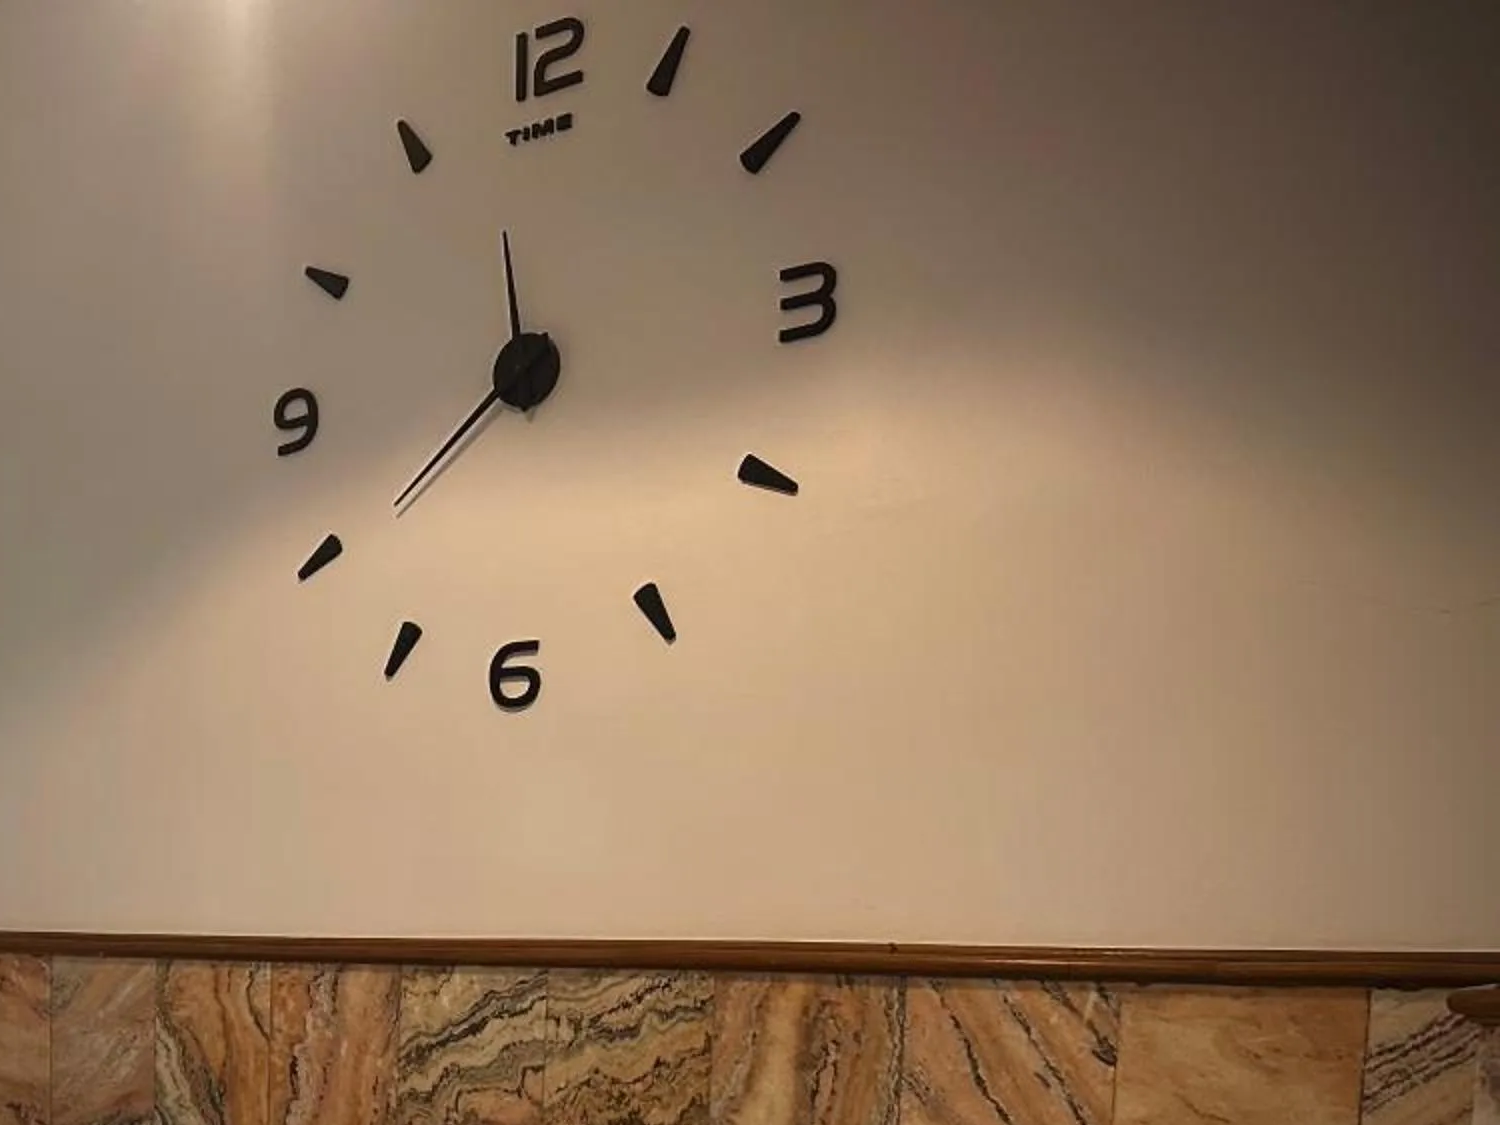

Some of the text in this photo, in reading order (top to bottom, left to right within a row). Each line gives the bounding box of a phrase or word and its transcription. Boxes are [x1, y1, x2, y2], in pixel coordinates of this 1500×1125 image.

[515, 17, 585, 102] 12
[504, 112, 573, 147] TIME
[779, 261, 837, 344] 3
[273, 387, 319, 457] 9
[489, 640, 541, 710] 6
